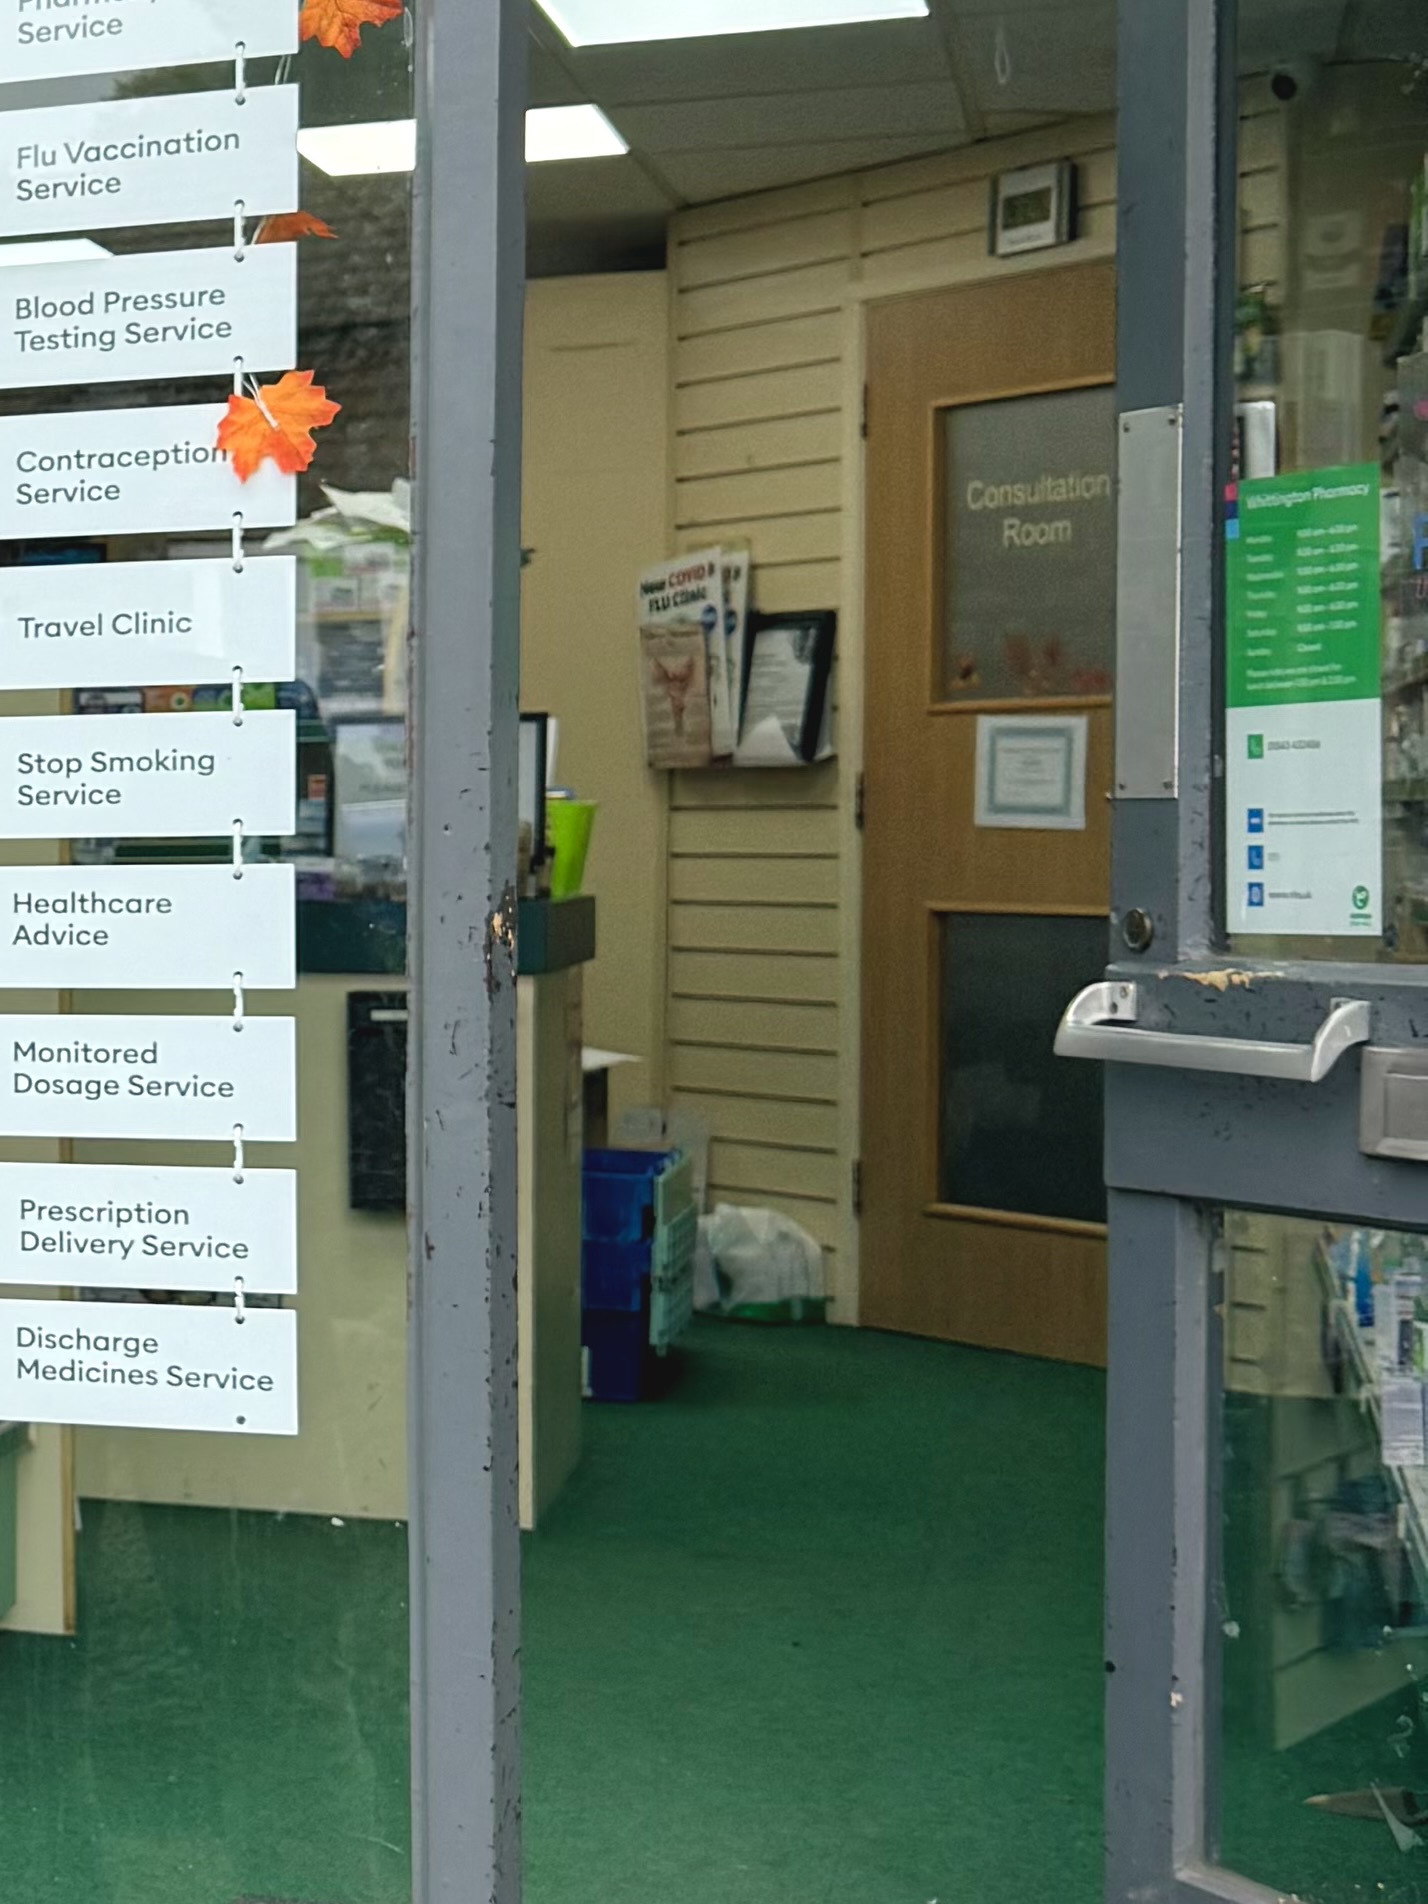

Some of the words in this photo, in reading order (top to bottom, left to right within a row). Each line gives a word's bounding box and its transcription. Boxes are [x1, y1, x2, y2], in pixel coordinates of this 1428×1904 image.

[17, 14, 124, 45] Service
[17, 143, 57, 170] Flu
[63, 128, 240, 165] Vaccination
[16, 172, 122, 202] Service
[15, 290, 95, 321] Blood
[103, 288, 226, 314] Pressure
[13, 325, 116, 353] Testing
[124, 316, 233, 345] Service
[16, 440, 228, 474] Contraception
[15, 478, 121, 506] Service
[965, 471, 1112, 512] Consultation
[1001, 516, 1073, 549] Room
[668, 565, 707, 588] COVID
[16, 612, 103, 639] Travel
[111, 610, 193, 636] Clinic
[17, 752, 83, 780] Stop
[90, 747, 215, 777] Smoking
[17, 782, 122, 807] Service
[13, 890, 173, 915] Healthcare
[11, 922, 110, 946] Advice
[13, 1040, 158, 1065] Monitored
[13, 1072, 120, 1101] Dosage
[127, 1073, 235, 1098] Service
[20, 1198, 190, 1229] Prescription
[20, 1229, 135, 1261] Delivery
[141, 1233, 249, 1260] Service
[16, 1325, 159, 1359] Discharge
[16, 1357, 159, 1387] Medicines
[165, 1364, 275, 1392] Service
